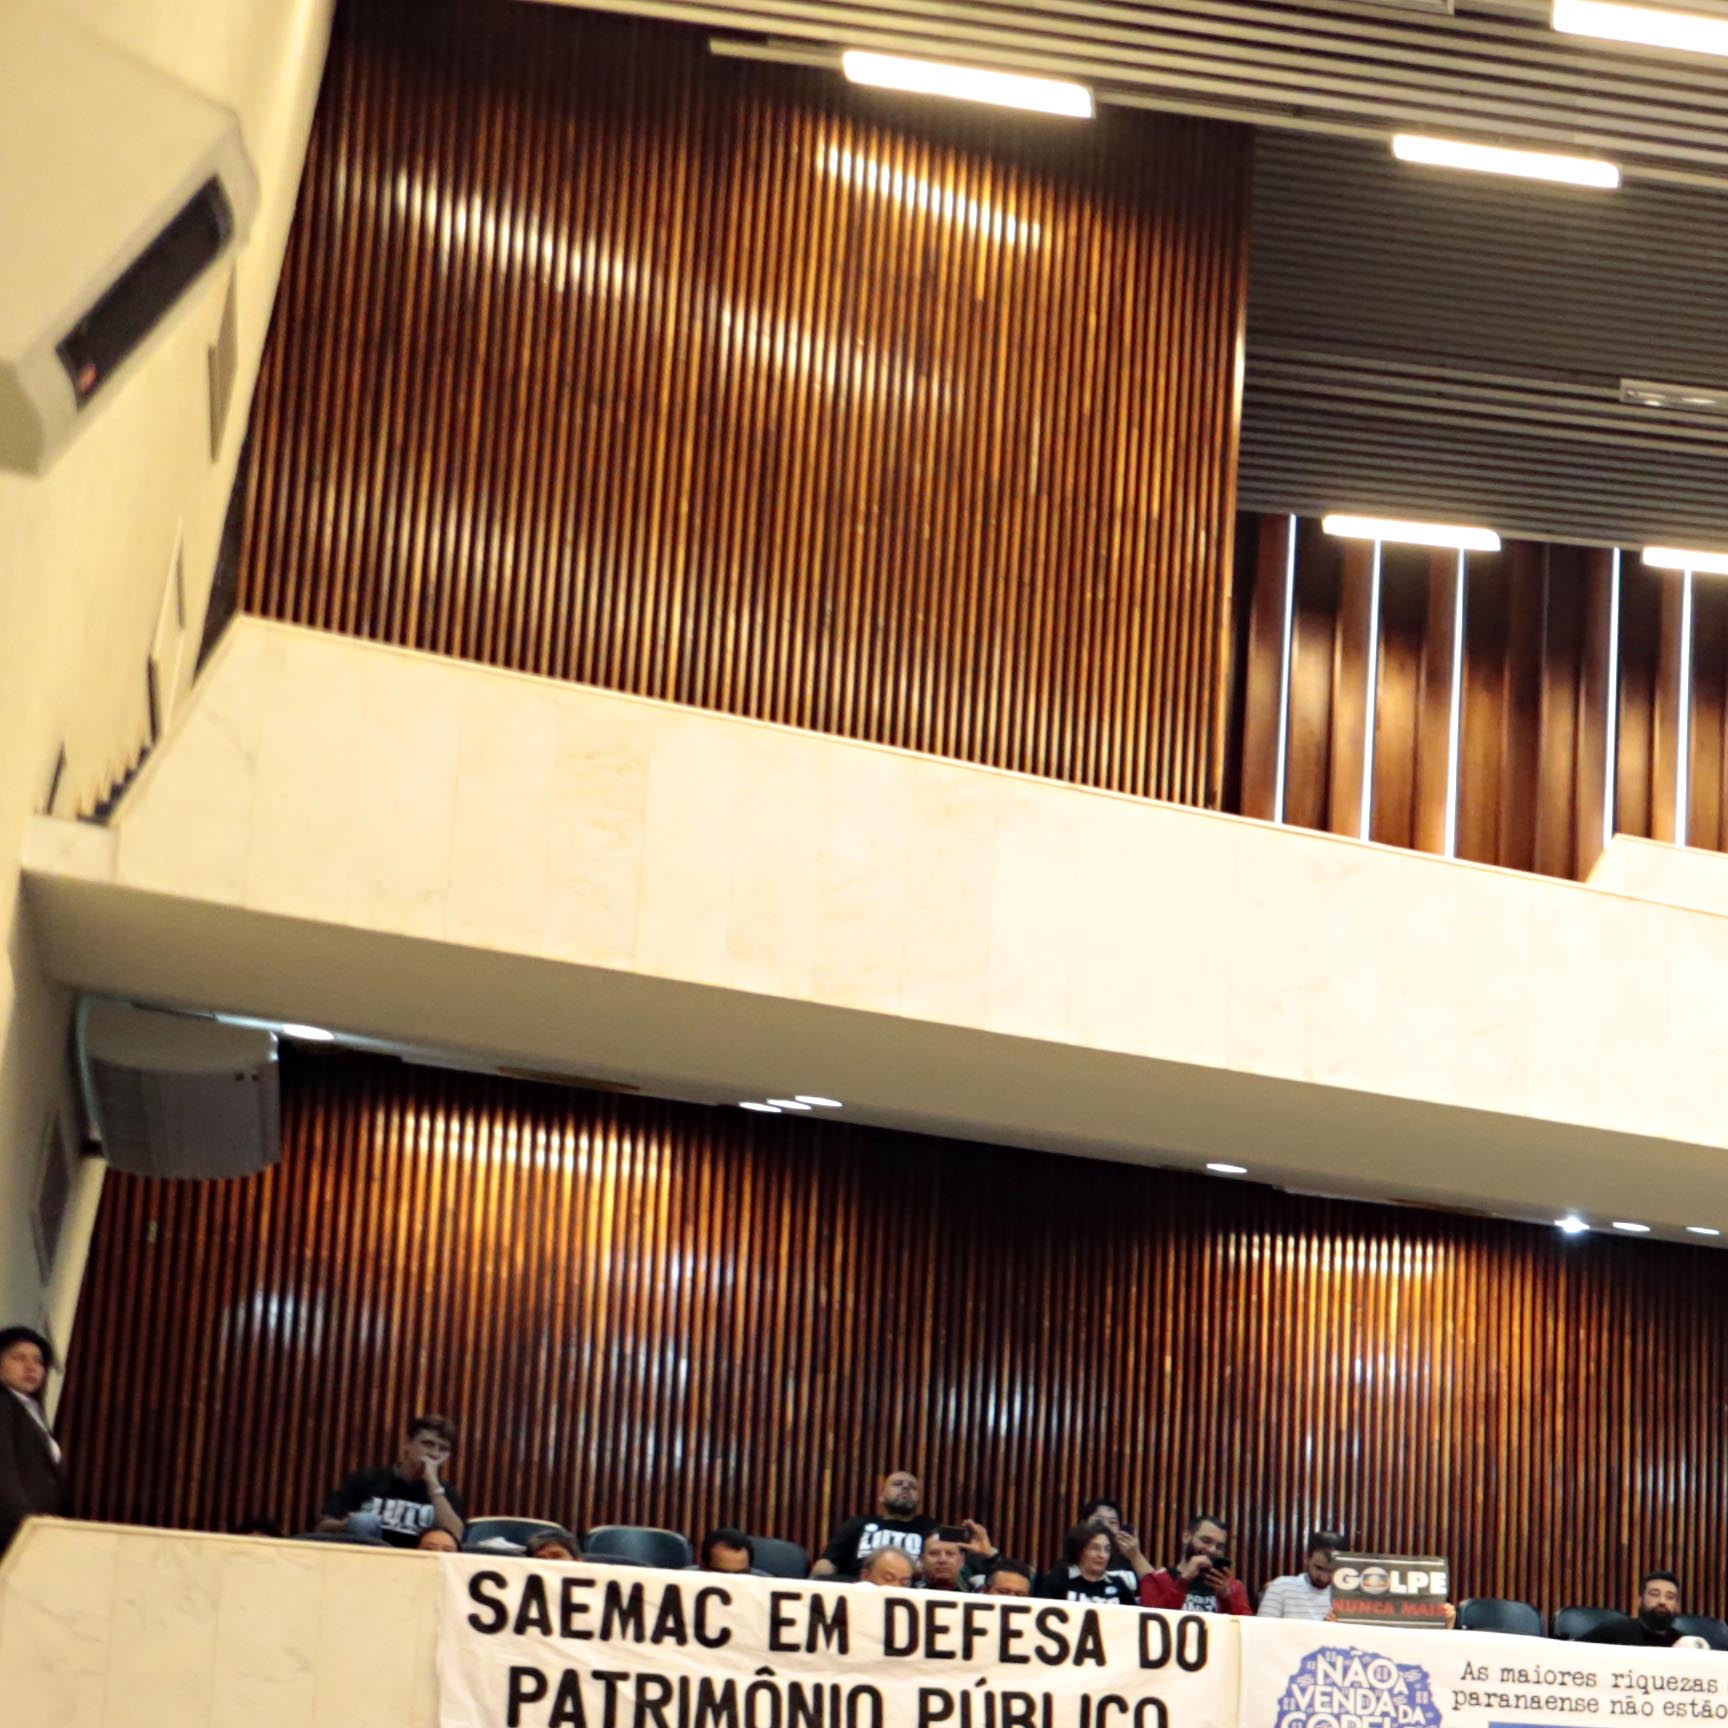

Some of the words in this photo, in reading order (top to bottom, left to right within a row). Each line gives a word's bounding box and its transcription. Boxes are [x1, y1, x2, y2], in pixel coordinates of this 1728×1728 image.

[858, 1528, 922, 1554] LUTO
[1333, 1567, 1447, 1595] GOLPE
[467, 1569, 732, 1649] SAEMAC
[768, 1594, 849, 1656] EM
[884, 1599, 1107, 1669] DEFESA
[1138, 1614, 1208, 1673] DO
[1333, 1598, 1397, 1616] NUNCA
[1315, 1649, 1399, 1690] NÃO
[1460, 1661, 1489, 1682] As
[1500, 1666, 1597, 1688] maiores
[1612, 1669, 1718, 1695] riquezas
[1291, 1683, 1397, 1718] VENDA
[1398, 1704, 1427, 1725] DA
[1452, 1688, 1600, 1713] paranaense
[1610, 1696, 1654, 1717] não
[1663, 1699, 1728, 1720] estão
